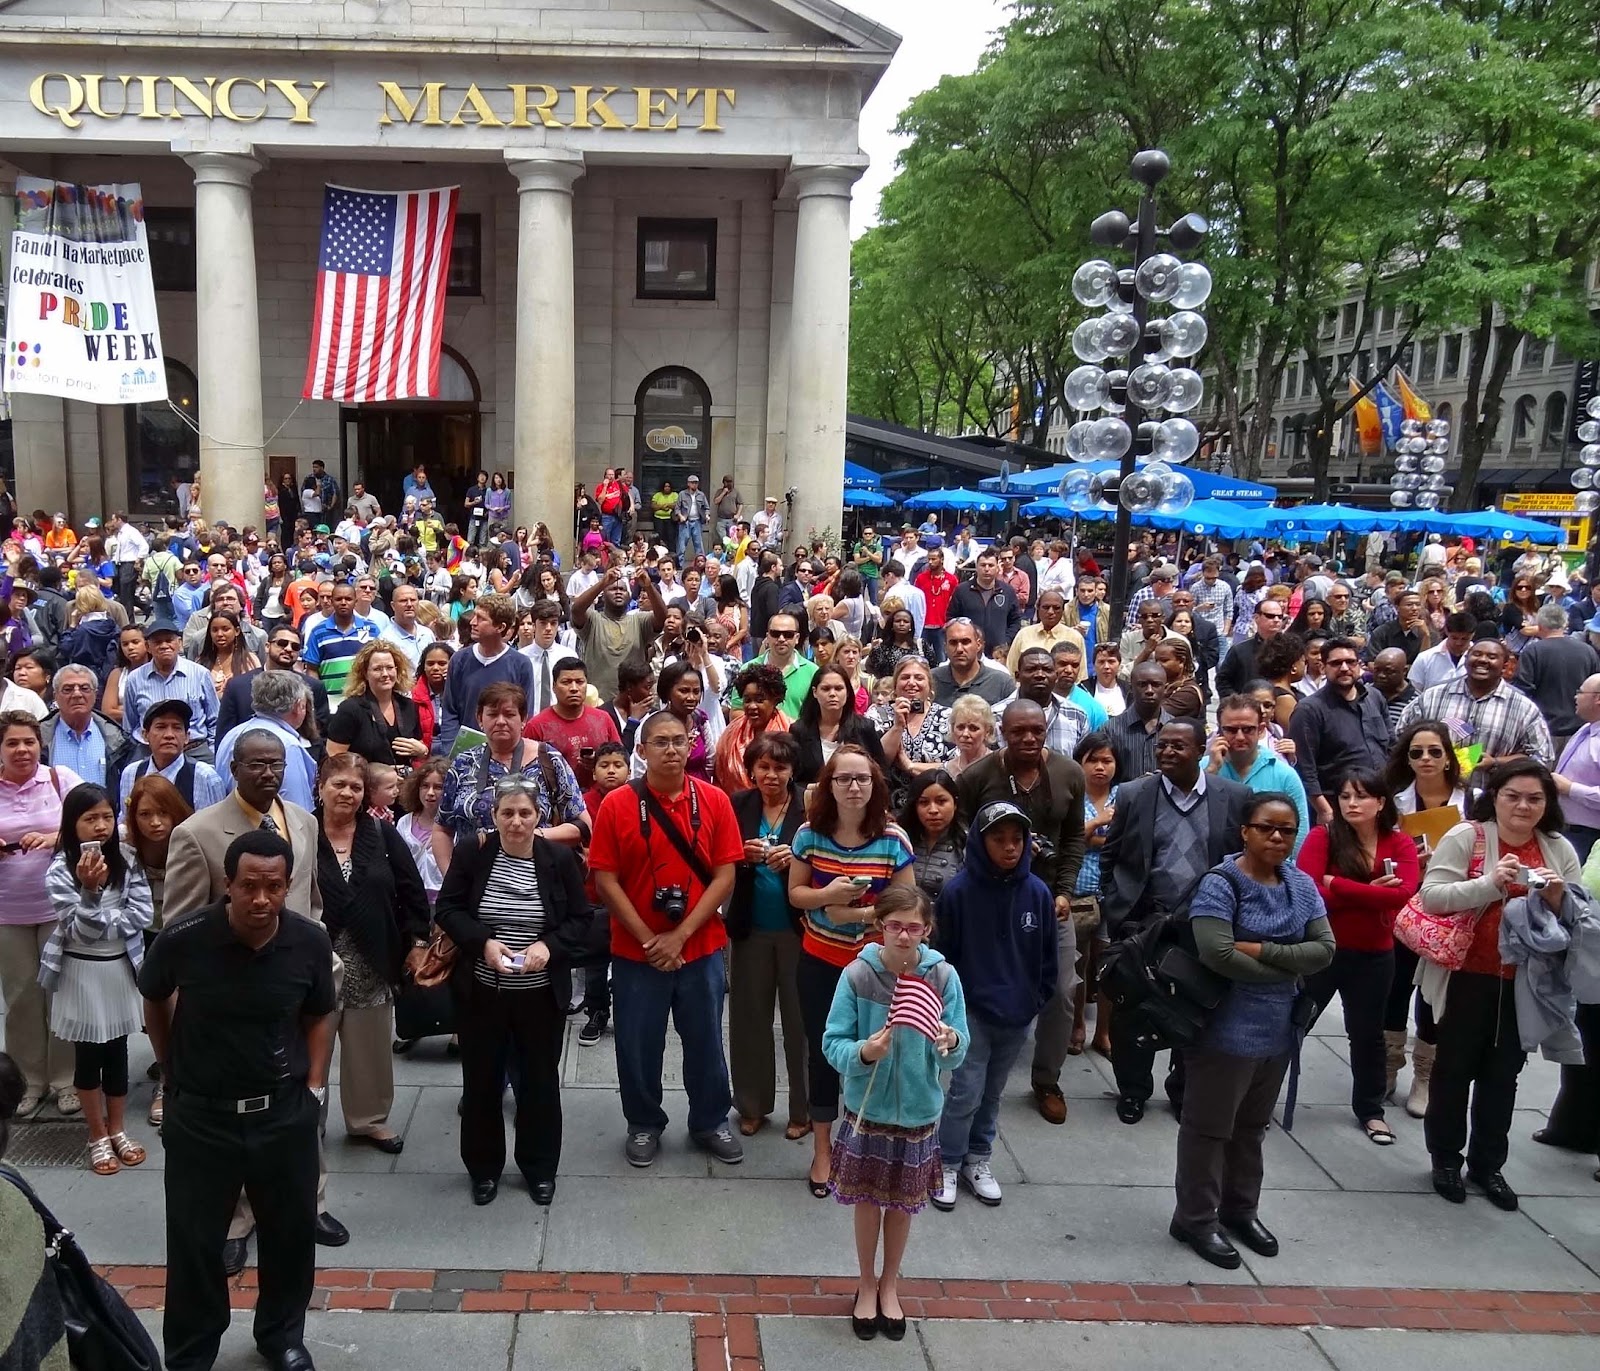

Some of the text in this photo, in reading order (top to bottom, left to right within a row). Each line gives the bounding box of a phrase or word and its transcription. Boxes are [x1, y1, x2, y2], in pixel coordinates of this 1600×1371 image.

[29, 72, 736, 132] QUINCY MARKET
[84, 333, 157, 362] WEEK
[653, 434, 696, 446] Bagelville
[1211, 489, 1263, 497] GREAT STEAKS
[1009, 774, 1018, 795] Canon
